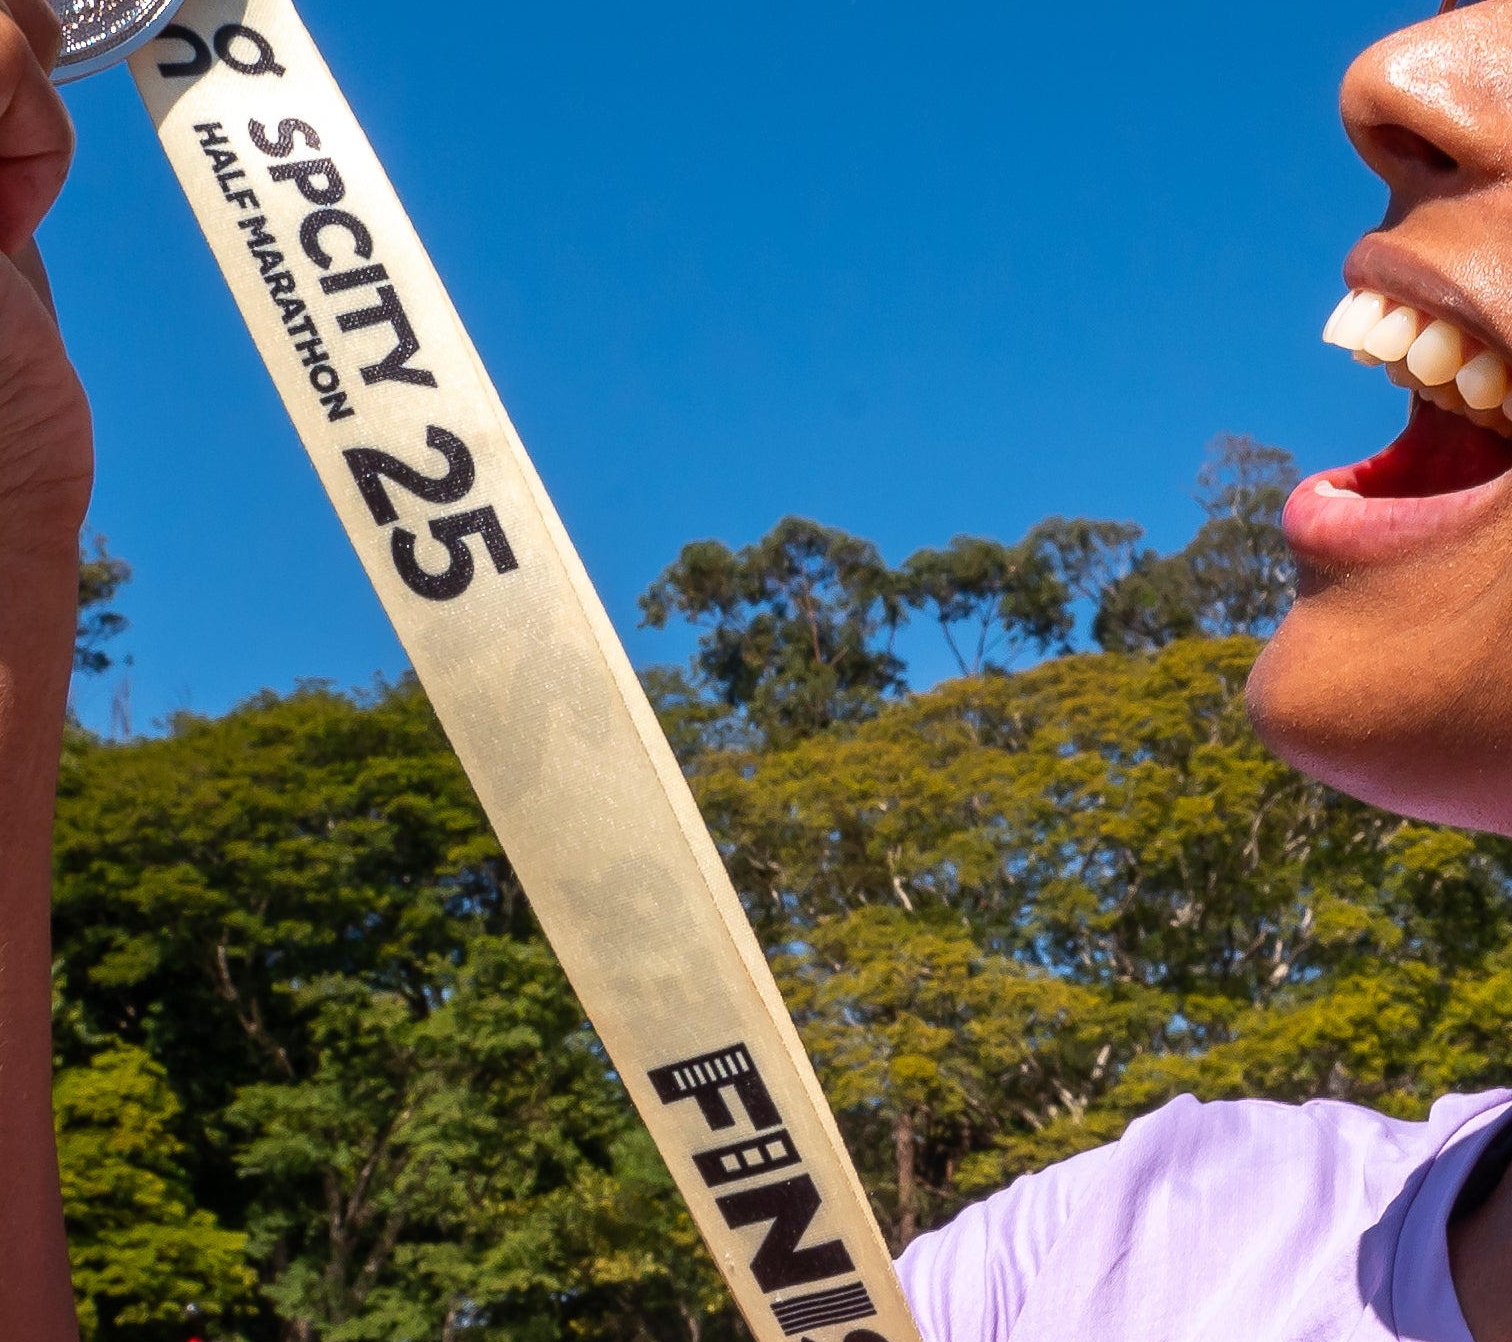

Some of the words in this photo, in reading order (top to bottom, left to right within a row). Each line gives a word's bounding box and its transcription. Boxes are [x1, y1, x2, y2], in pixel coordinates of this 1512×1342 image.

[194, 121, 260, 210] HALF
[238, 211, 355, 423] MARATHON
[247, 117, 438, 389] SPCITY
[343, 424, 519, 602] 25
